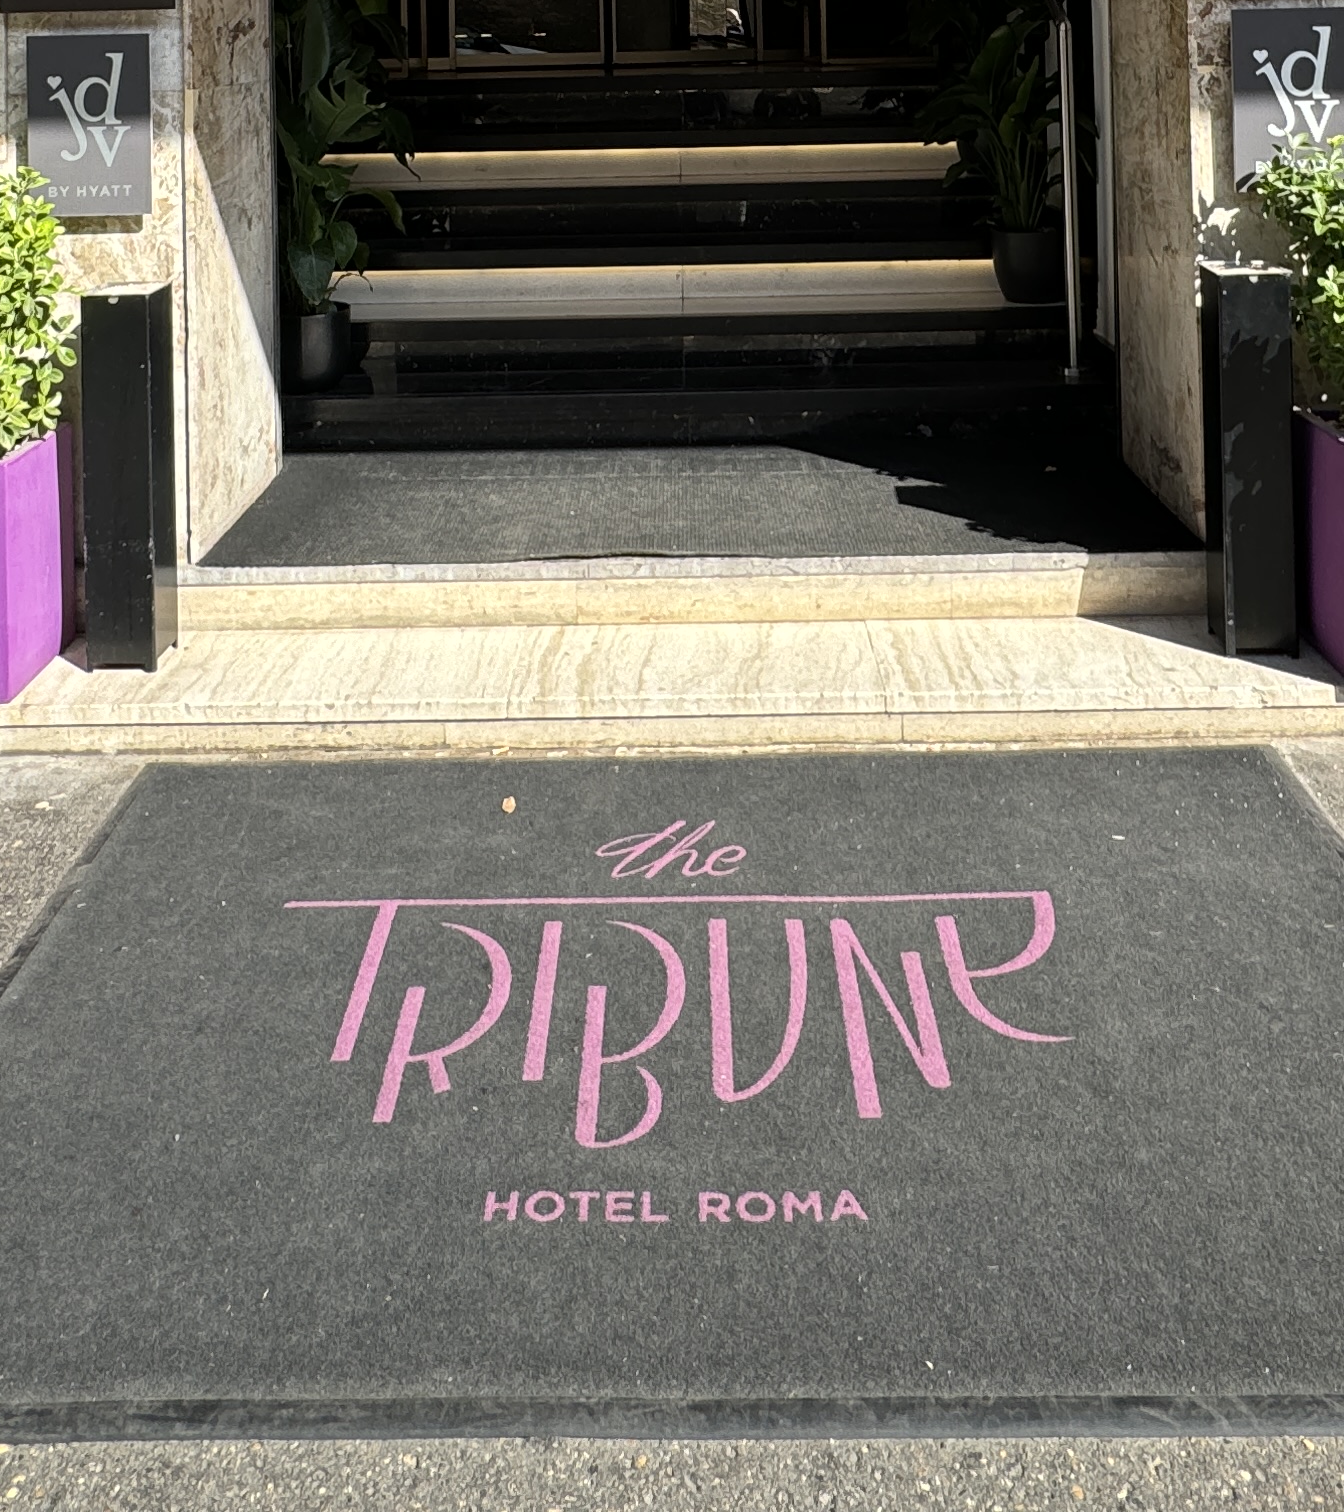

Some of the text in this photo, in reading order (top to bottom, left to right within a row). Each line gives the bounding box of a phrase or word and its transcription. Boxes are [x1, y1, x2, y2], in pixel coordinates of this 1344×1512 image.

[48, 184, 132, 198] BY HYATT
[595, 819, 747, 879] the
[283, 889, 1076, 1149] TRIBUNE
[483, 1190, 869, 1222] HOTEL ROMA
